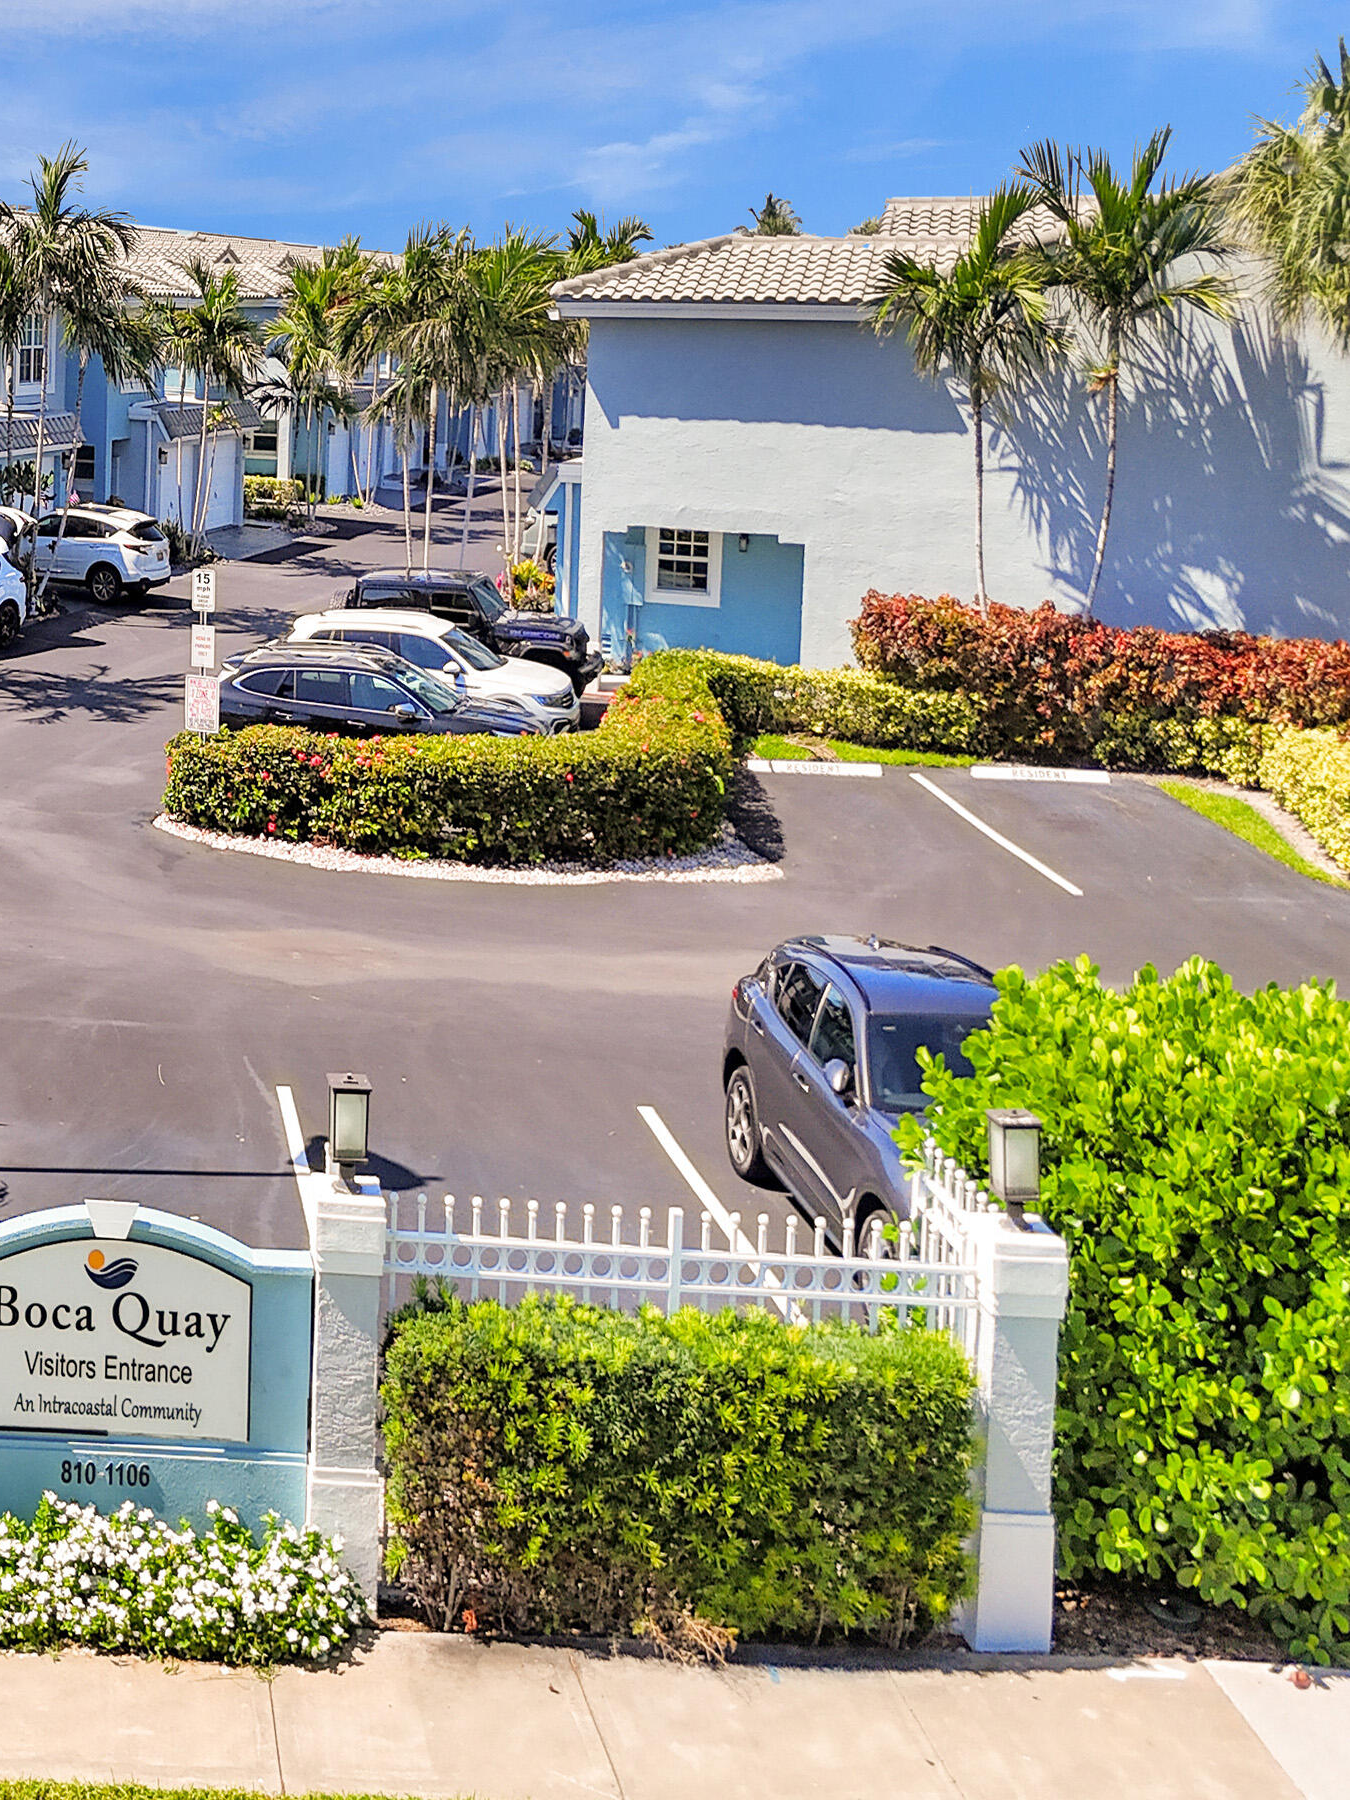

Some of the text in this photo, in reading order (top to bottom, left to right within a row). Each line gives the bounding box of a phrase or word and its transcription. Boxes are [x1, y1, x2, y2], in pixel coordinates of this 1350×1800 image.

[196, 573, 210, 584] 15
[786, 763, 840, 773] RESIDENT
[1012, 769, 1067, 779] RESIDENT
[112, 1291, 231, 1353] Quay
[24, 1350, 193, 1385] Visitors Entrance
[13, 1393, 202, 1428] An Intracoastal Community
